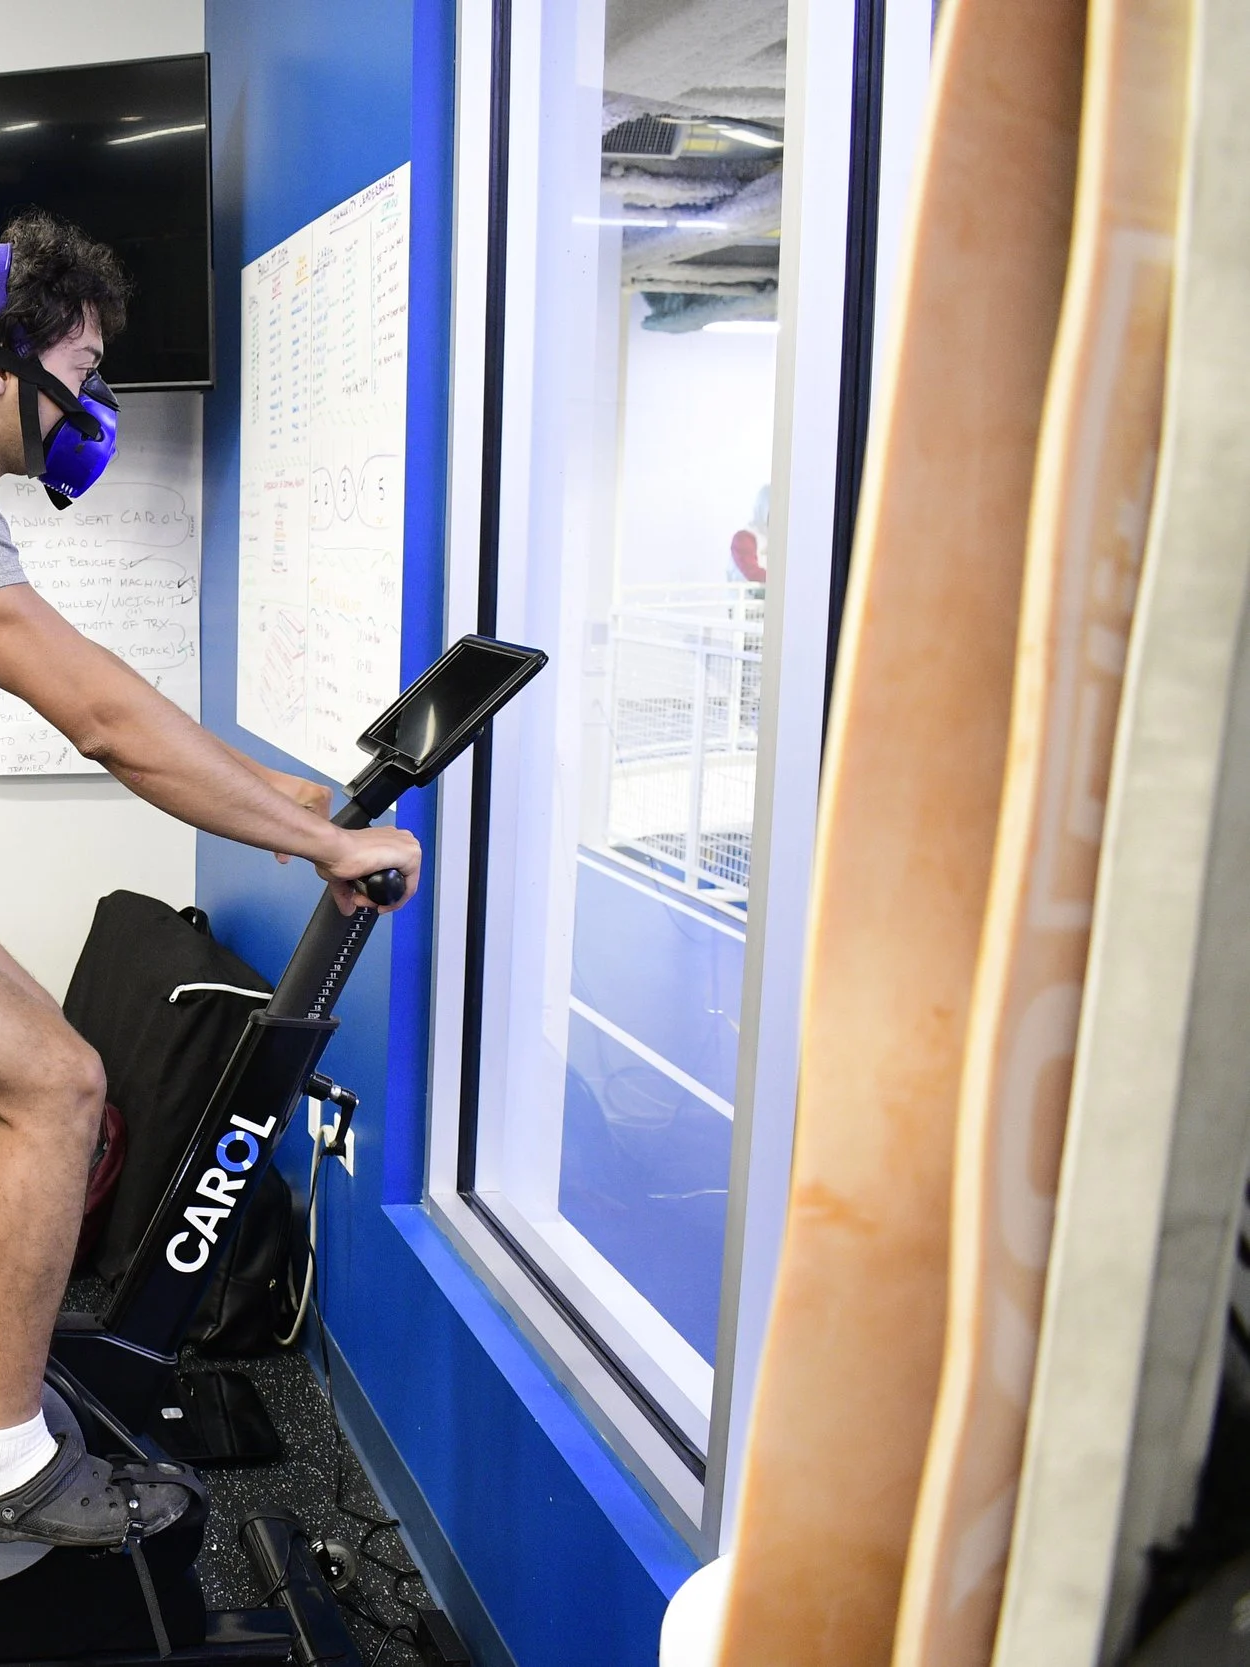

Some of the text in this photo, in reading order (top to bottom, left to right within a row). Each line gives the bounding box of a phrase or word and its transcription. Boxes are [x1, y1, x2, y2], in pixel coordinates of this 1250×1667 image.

[10, 509, 184, 528] ADJUST SEAT CAROL
[45, 538, 103, 548] CAROL
[20, 556, 129, 569] DJUST BENCHES
[52, 579, 71, 589] ON
[80, 577, 112, 588] SMITH
[120, 578, 178, 589] MACHINE
[122, 619, 139, 629] OF
[143, 618, 170, 632] TRX
[129, 641, 176, 660] (TRACK)
[0, 713, 30, 722] BALL
[0, 736, 15, 746] TO
[165, 1114, 277, 1273] CAROL
